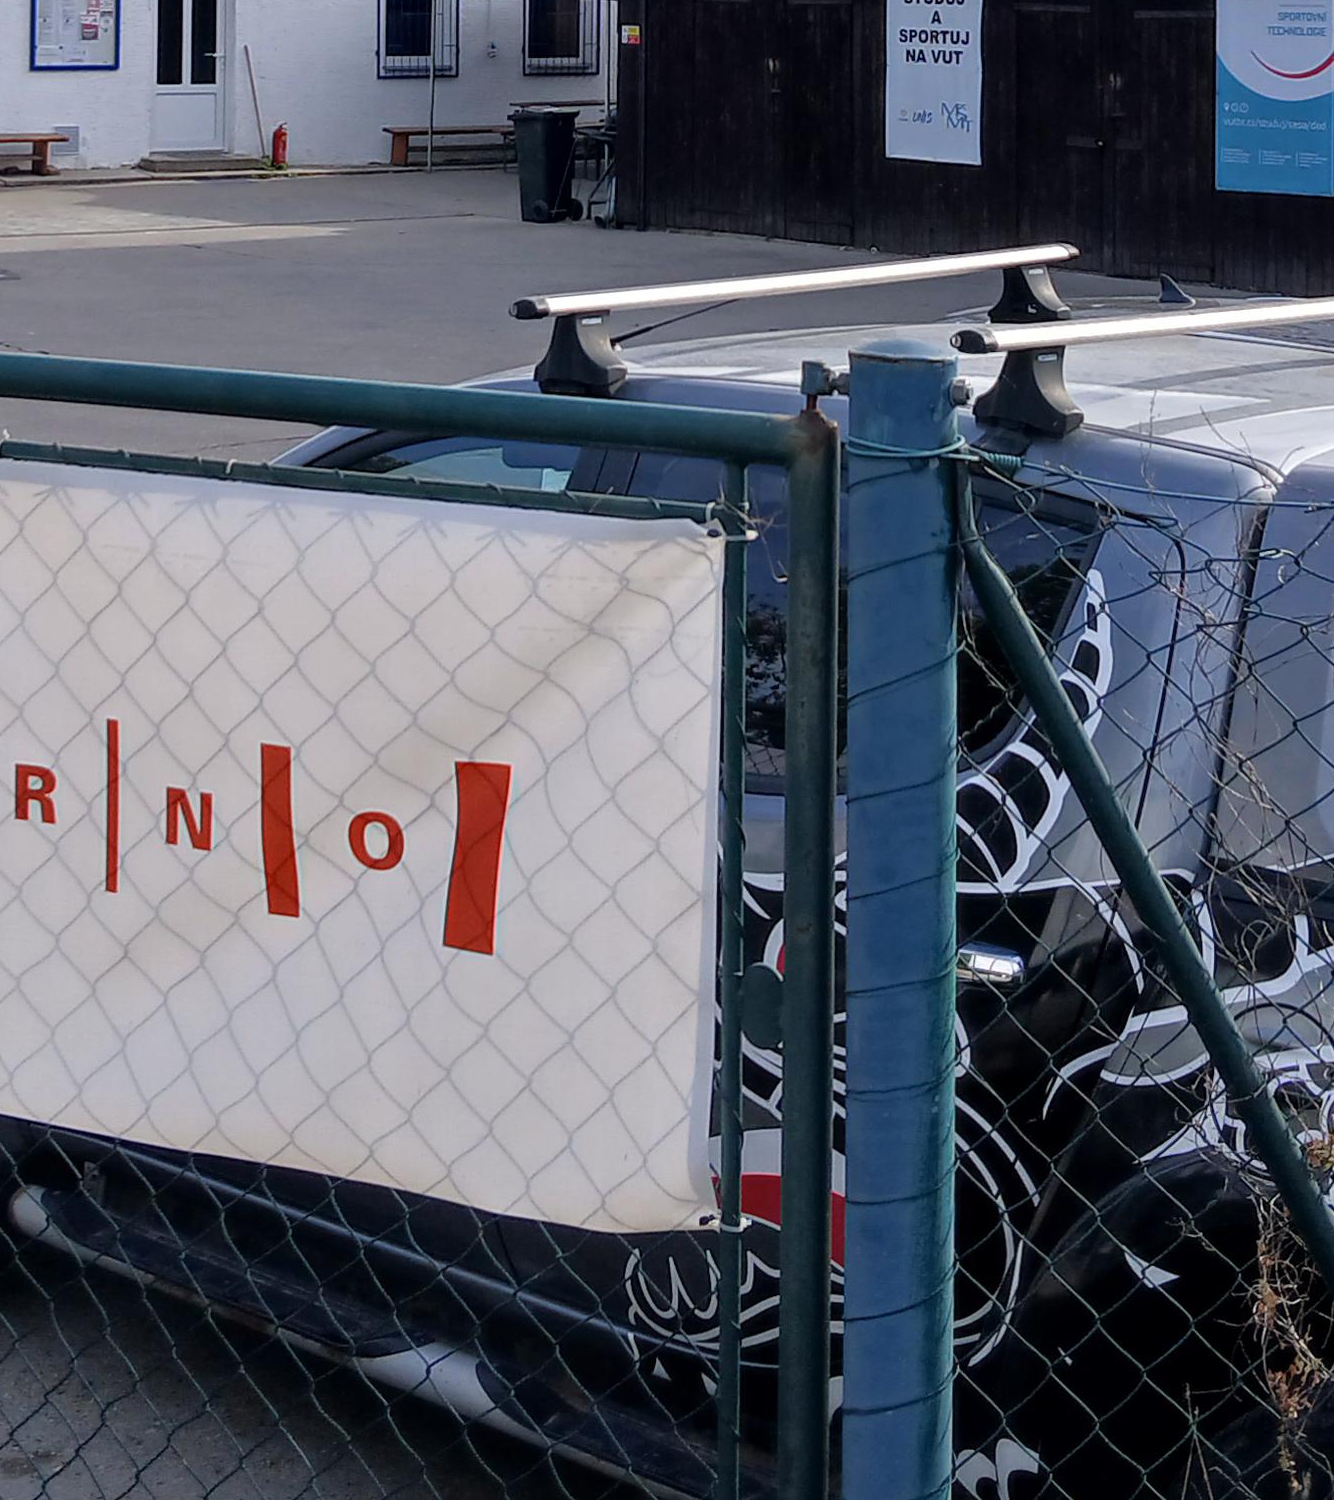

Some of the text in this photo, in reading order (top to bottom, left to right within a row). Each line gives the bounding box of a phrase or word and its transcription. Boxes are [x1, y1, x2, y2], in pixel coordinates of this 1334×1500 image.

[930, 10, 942, 25] A
[1277, 11, 1327, 22] SPORTOVNÍ
[898, 28, 971, 46] SPORTUJ
[1267, 25, 1327, 37] TECHNOLOGIE
[905, 48, 964, 65] NA VUT
